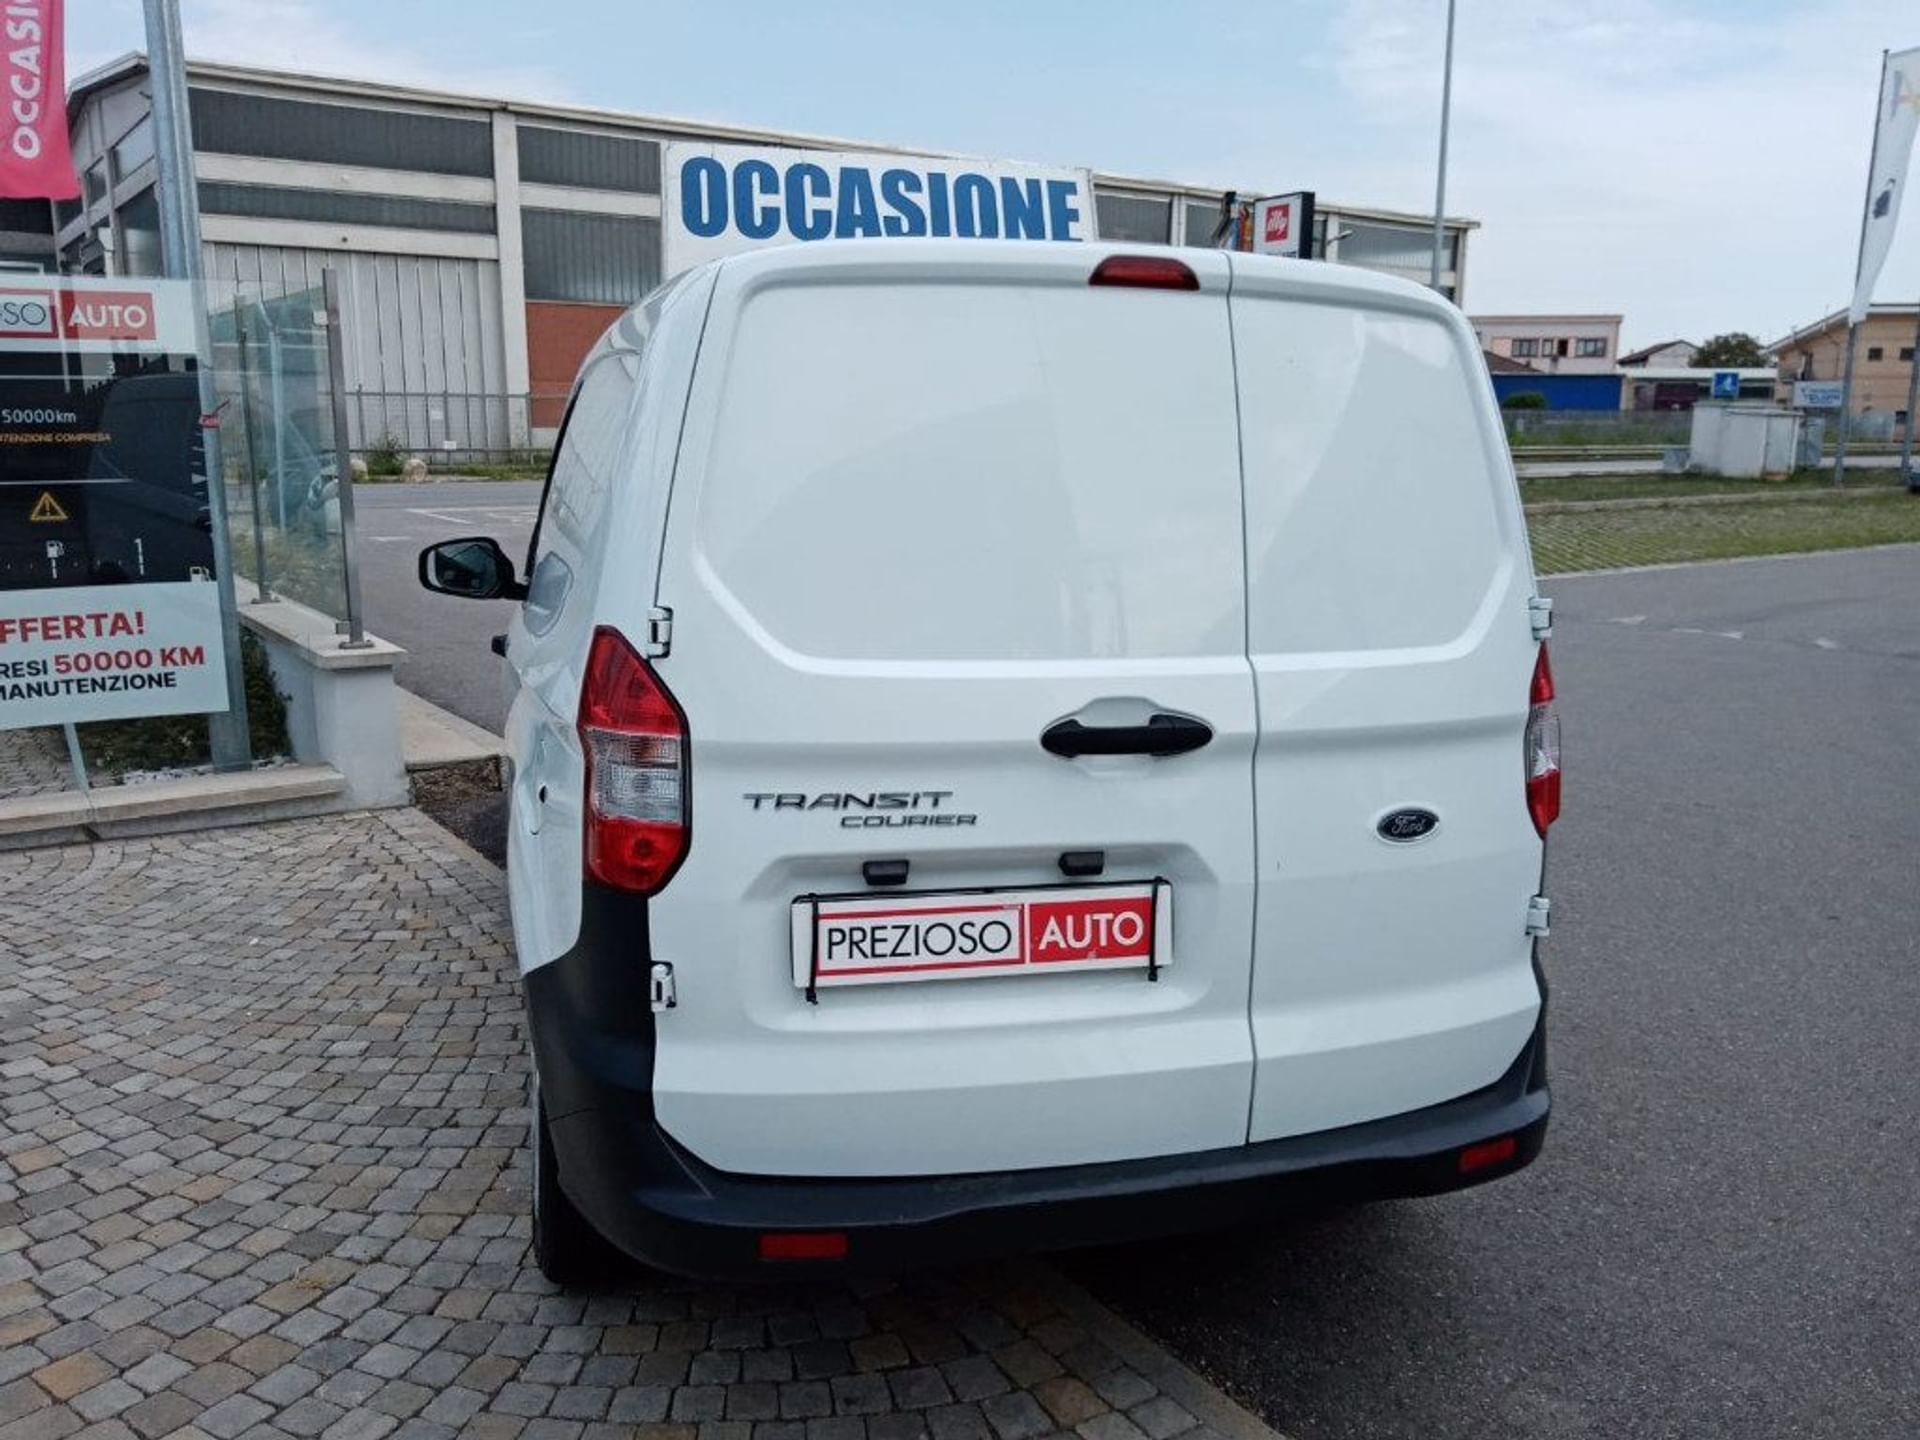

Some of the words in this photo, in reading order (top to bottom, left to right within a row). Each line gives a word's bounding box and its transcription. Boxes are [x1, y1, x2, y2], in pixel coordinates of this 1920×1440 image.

[5, 0, 41, 159] OCCASI
[681, 157, 1083, 241] OCCASIONE
[0, 303, 46, 326] SO
[69, 304, 147, 328] AUTO
[55, 649, 153, 674] 50000
[160, 646, 205, 666] KM
[743, 792, 953, 810] TRANSIT
[841, 814, 977, 828] COURIER
[827, 920, 1012, 960] PREZIOSO
[1039, 911, 1144, 951] AUTO
